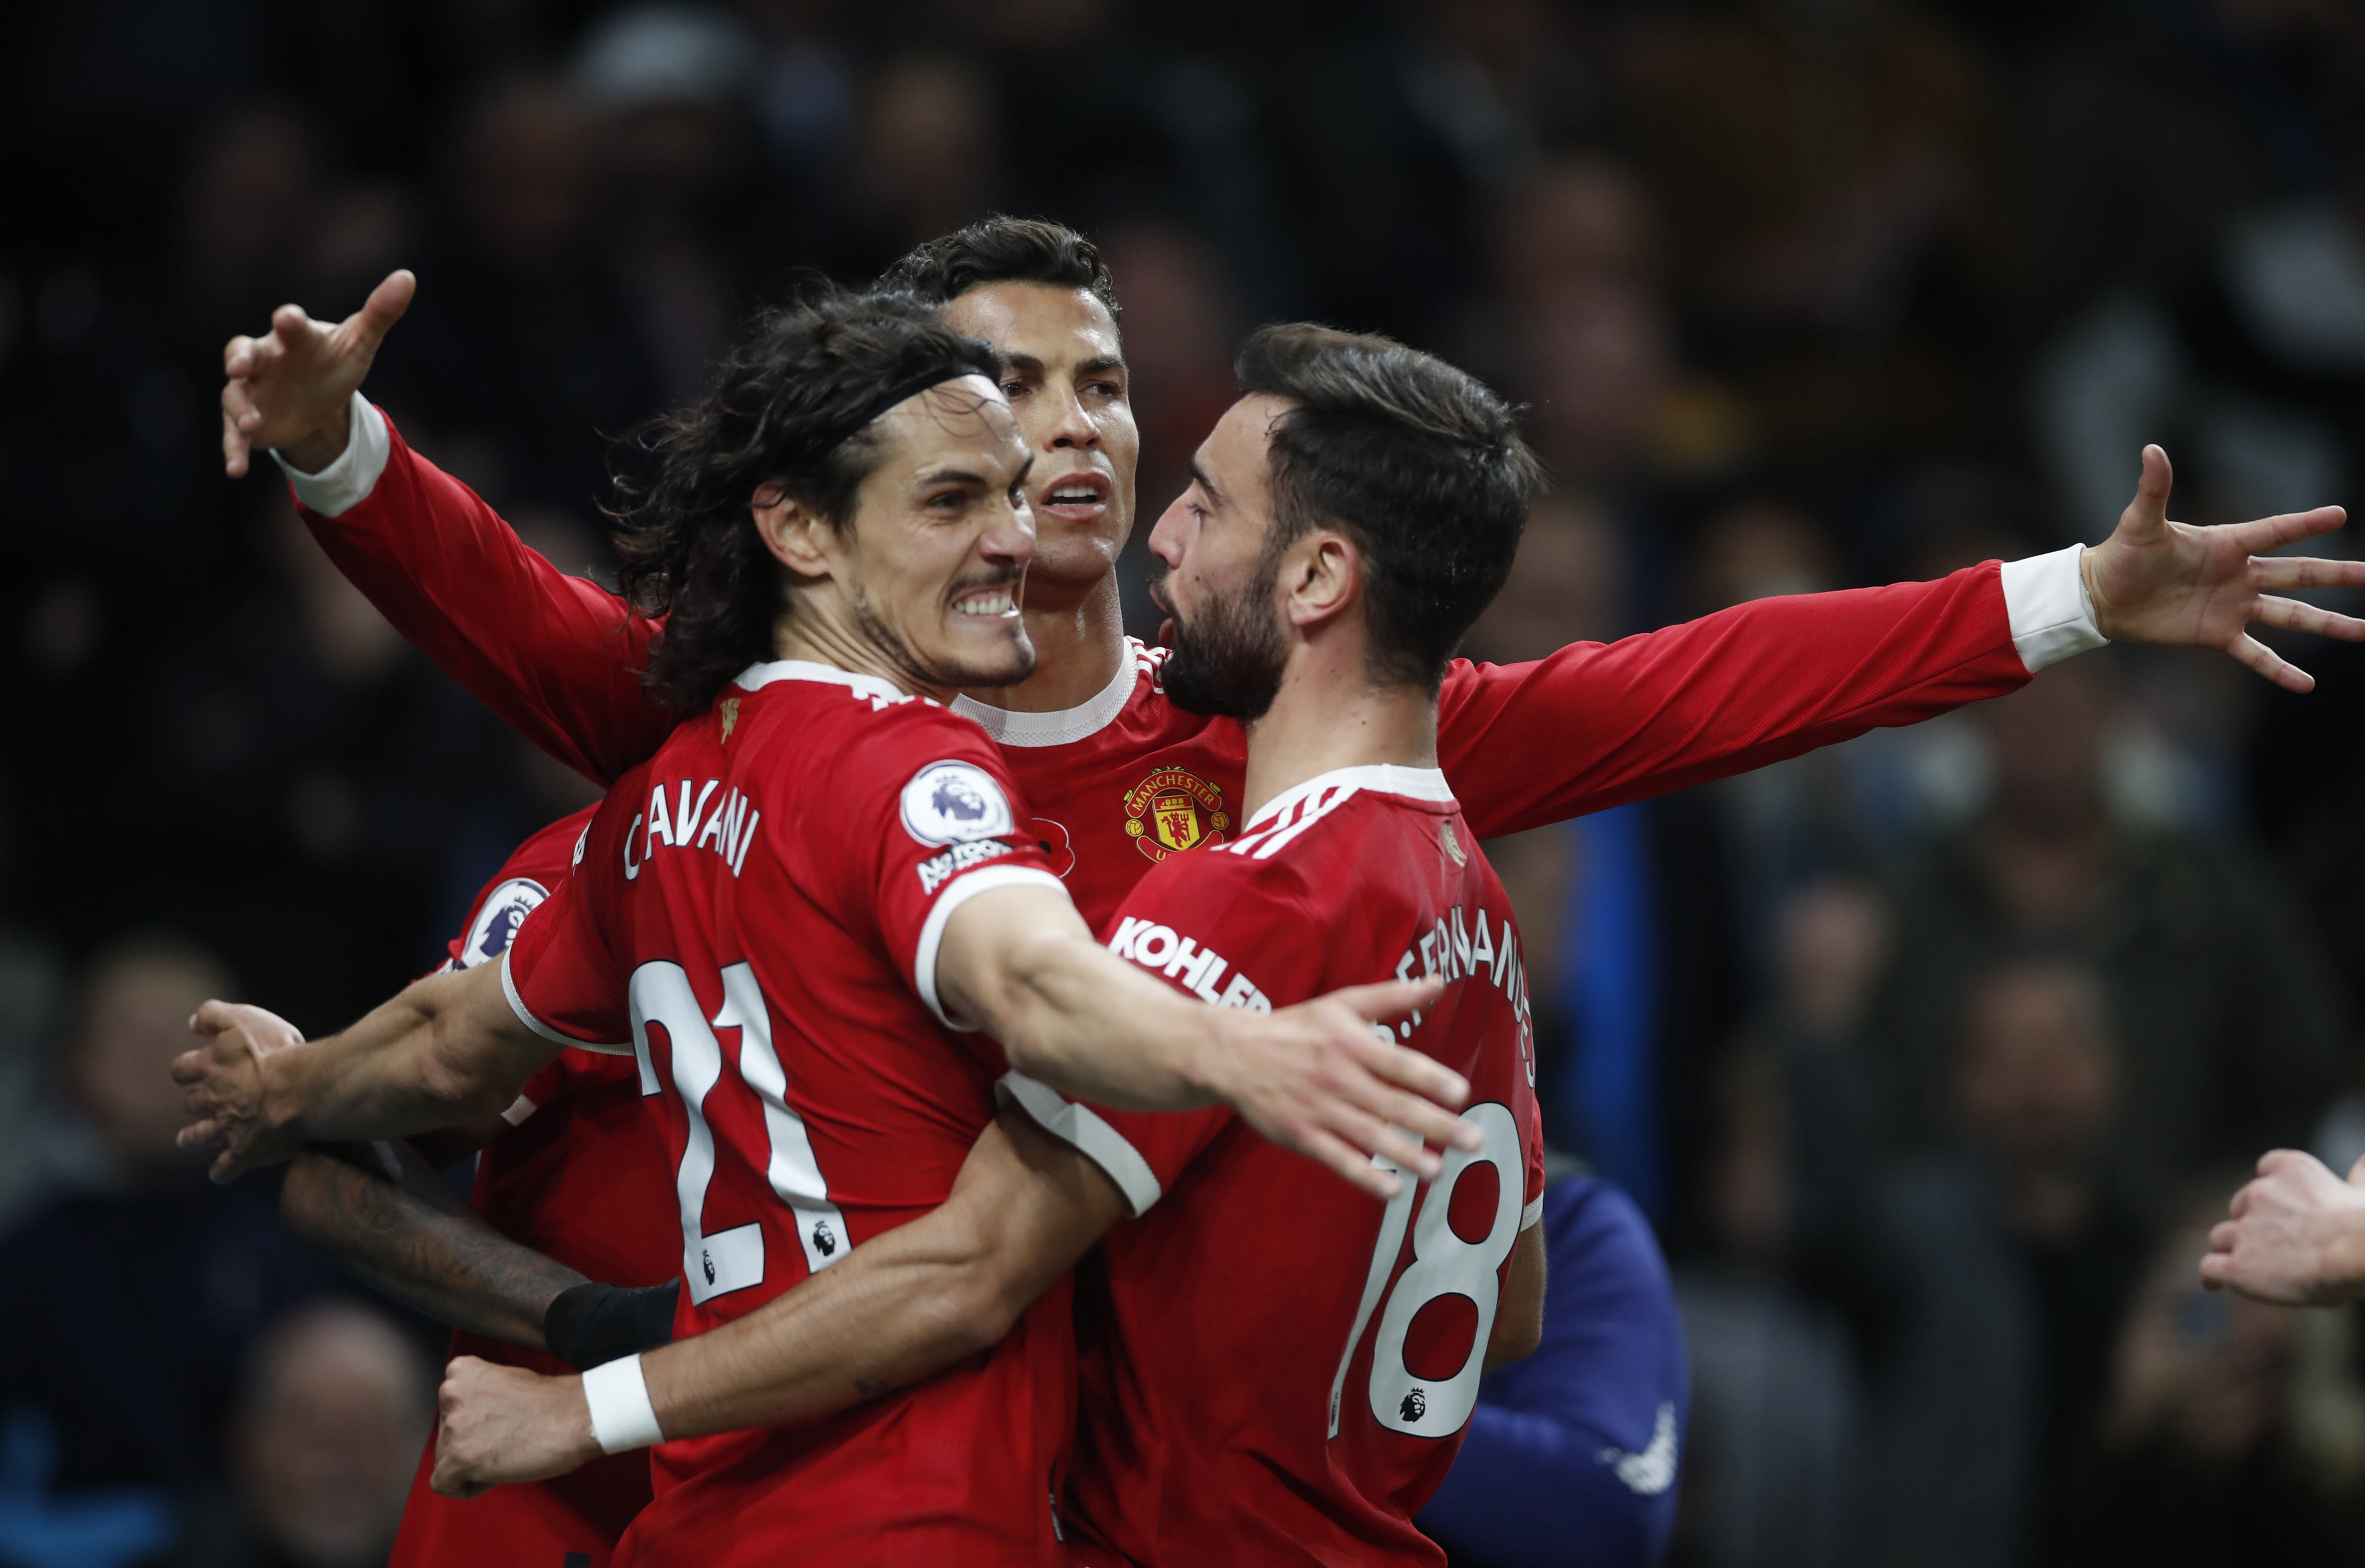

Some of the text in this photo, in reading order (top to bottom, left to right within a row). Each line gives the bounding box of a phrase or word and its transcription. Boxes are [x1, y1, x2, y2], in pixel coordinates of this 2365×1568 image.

[624, 779, 760, 880] CAVANI
[1132, 775, 1214, 811] MANCHESTER
[629, 959, 853, 1307] 21
[1327, 1102, 1524, 1439] 18
